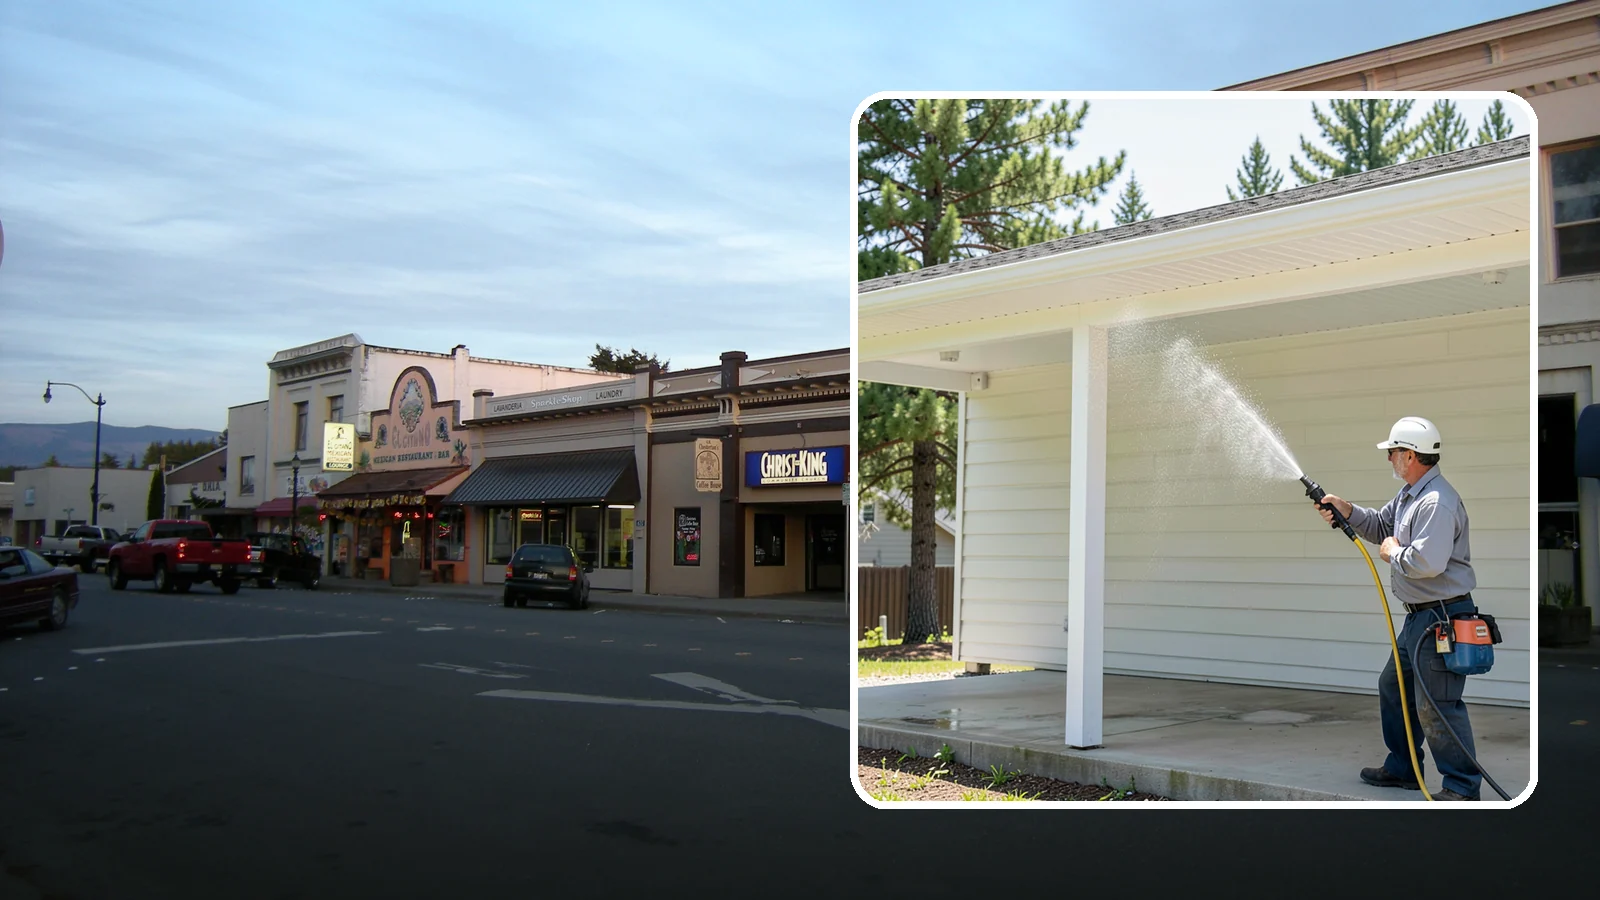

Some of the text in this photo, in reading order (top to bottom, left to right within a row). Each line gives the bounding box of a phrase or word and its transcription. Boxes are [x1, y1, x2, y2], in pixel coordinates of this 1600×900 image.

[493, 389, 624, 412] LAVANDERIA Sparkle Shop LAUNDRY
[373, 454, 396, 464] MEXICAN
[397, 451, 434, 462] RESTAURANT
[438, 450, 450, 459] BAR
[697, 480, 721, 489] Coffee House
